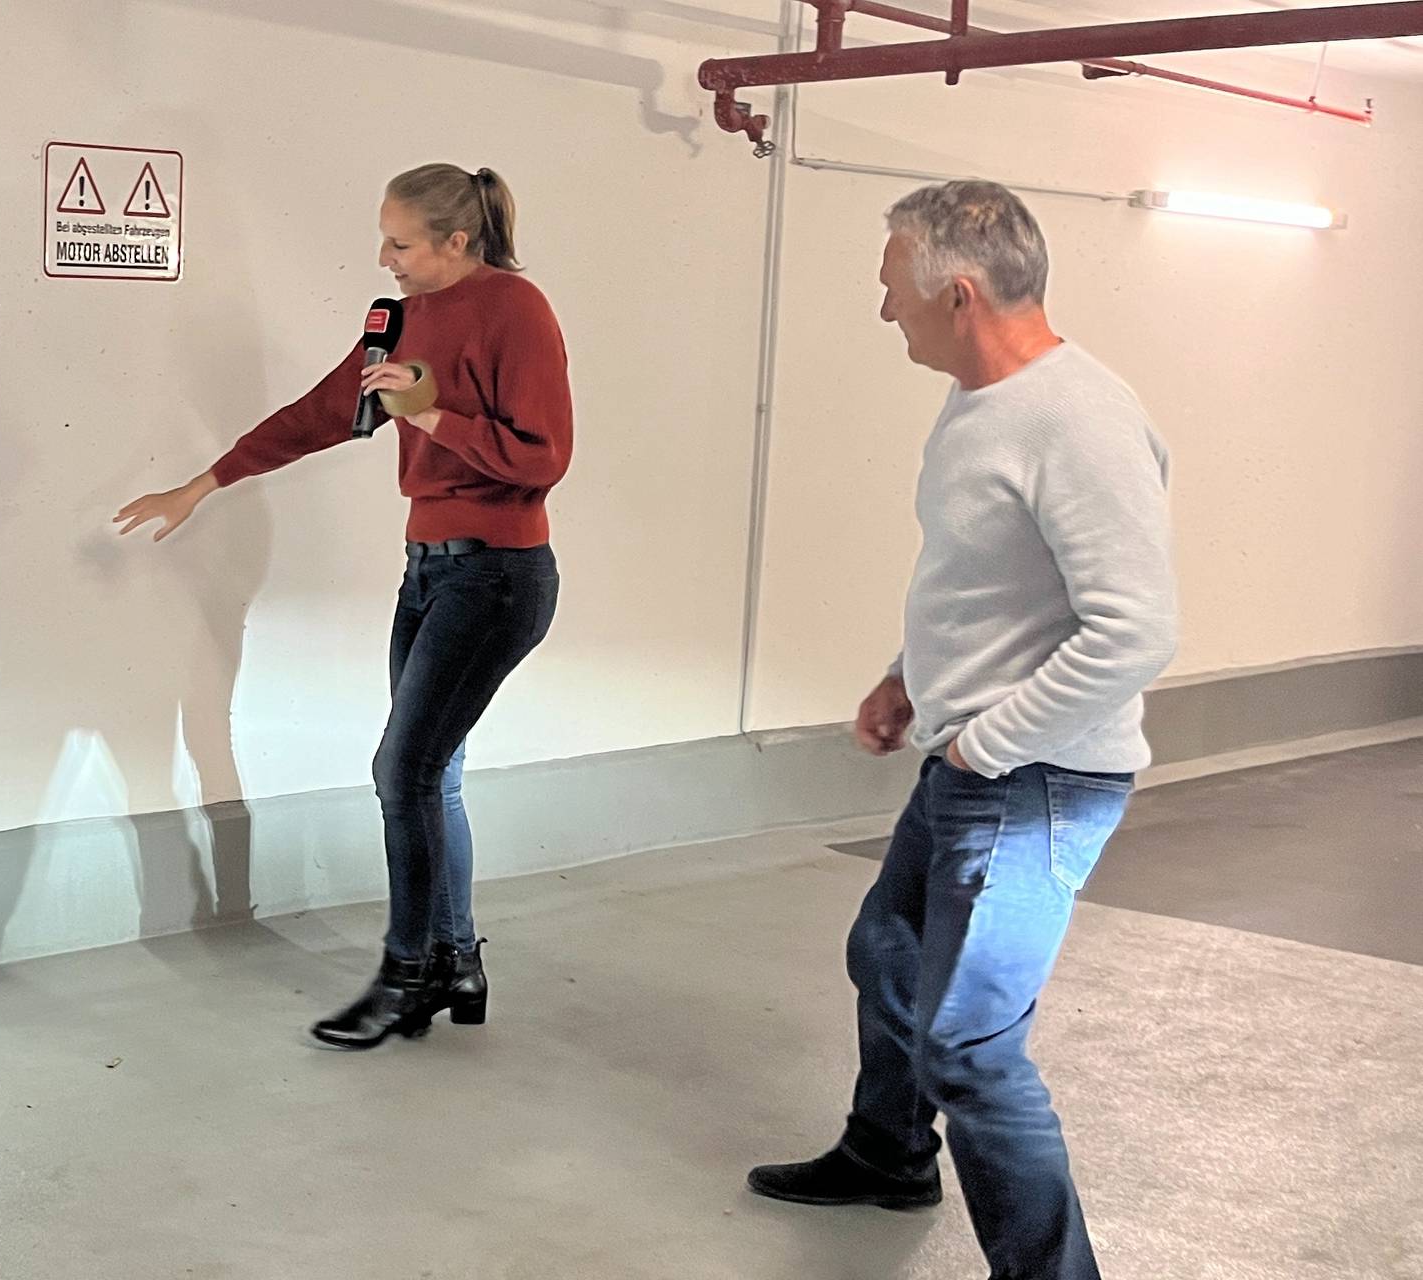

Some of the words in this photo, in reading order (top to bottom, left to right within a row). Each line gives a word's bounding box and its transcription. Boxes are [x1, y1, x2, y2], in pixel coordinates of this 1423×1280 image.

[56, 221, 70, 232] Bei
[72, 222, 122, 235] abgestellten
[124, 224, 170, 239] Fahrzeugen
[56, 241, 101, 262] MOTOR
[103, 244, 169, 264] ABSTELLEN
